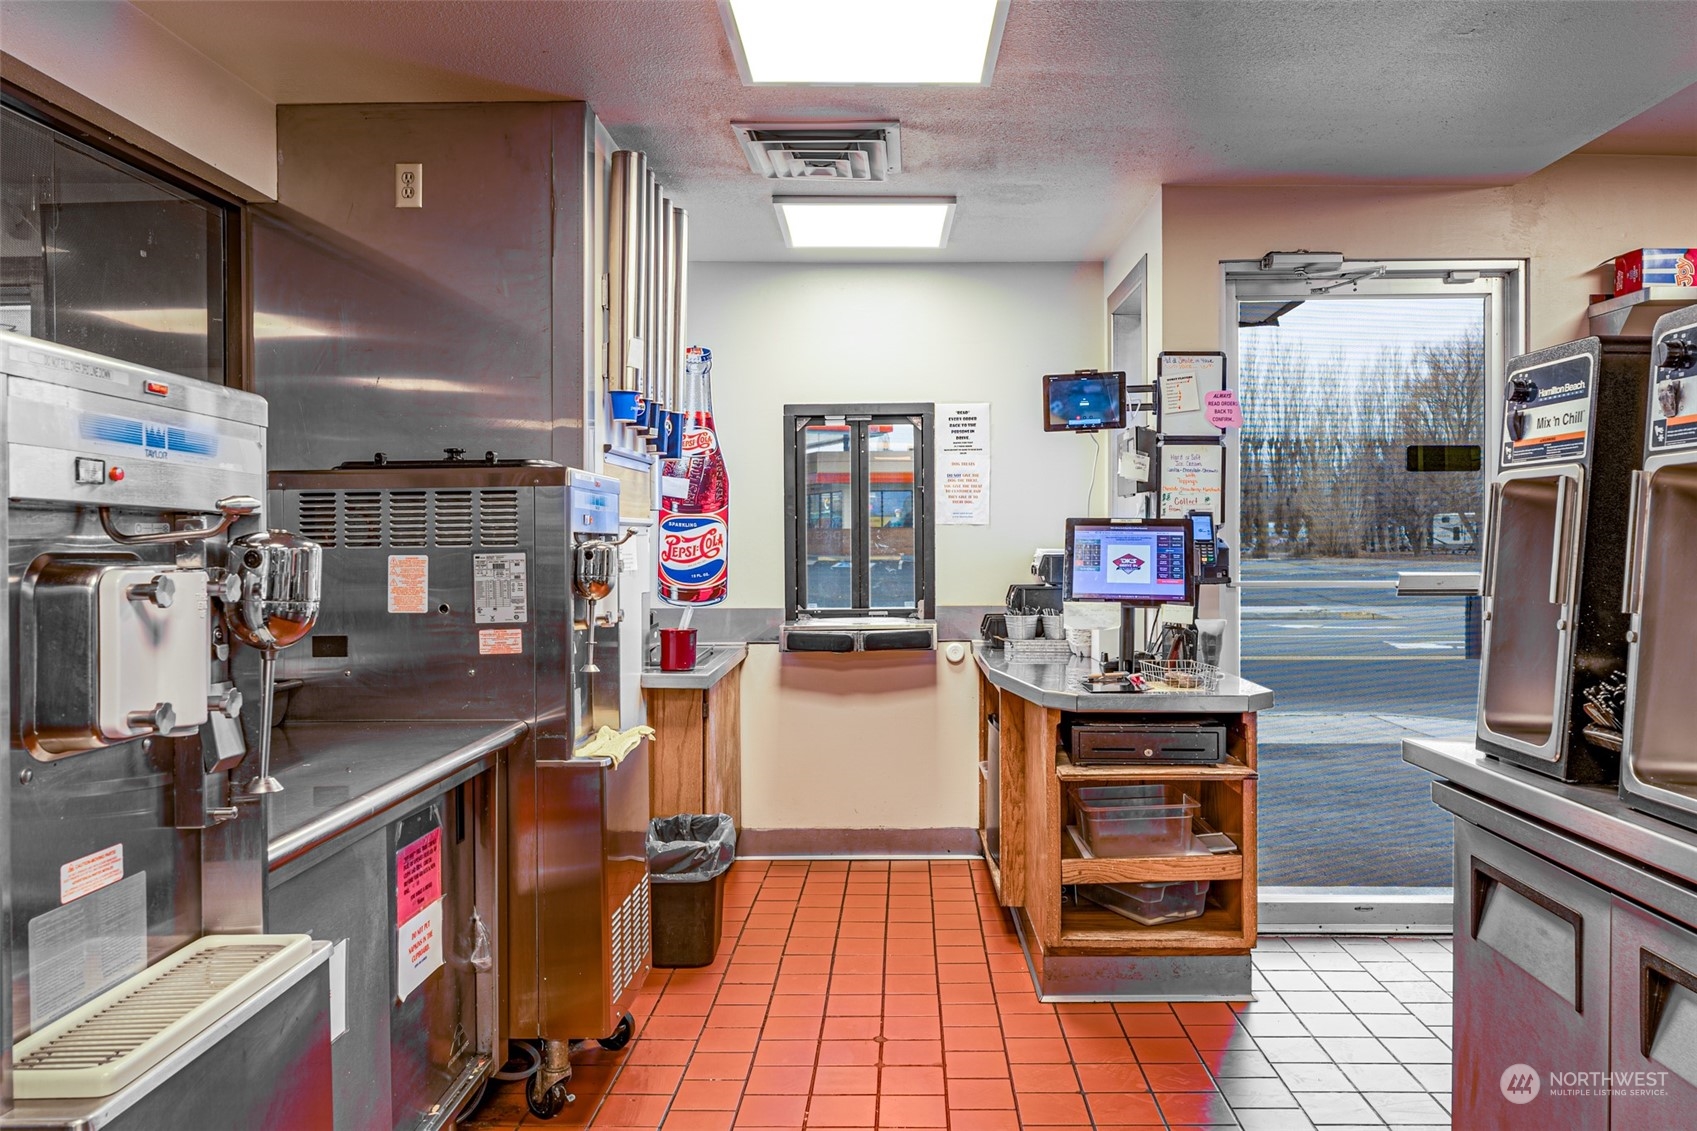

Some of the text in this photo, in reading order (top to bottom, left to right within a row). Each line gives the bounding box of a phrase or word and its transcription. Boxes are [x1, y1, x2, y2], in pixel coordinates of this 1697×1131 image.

[1675, 257, 1694, 286] Joy
[1538, 386, 1565, 397] Hamilton
[1537, 417, 1551, 429] Mix
[1553, 416, 1560, 426] 'n
[145, 449, 168, 460] TAYLOR
[1174, 497, 1198, 505] Collect
